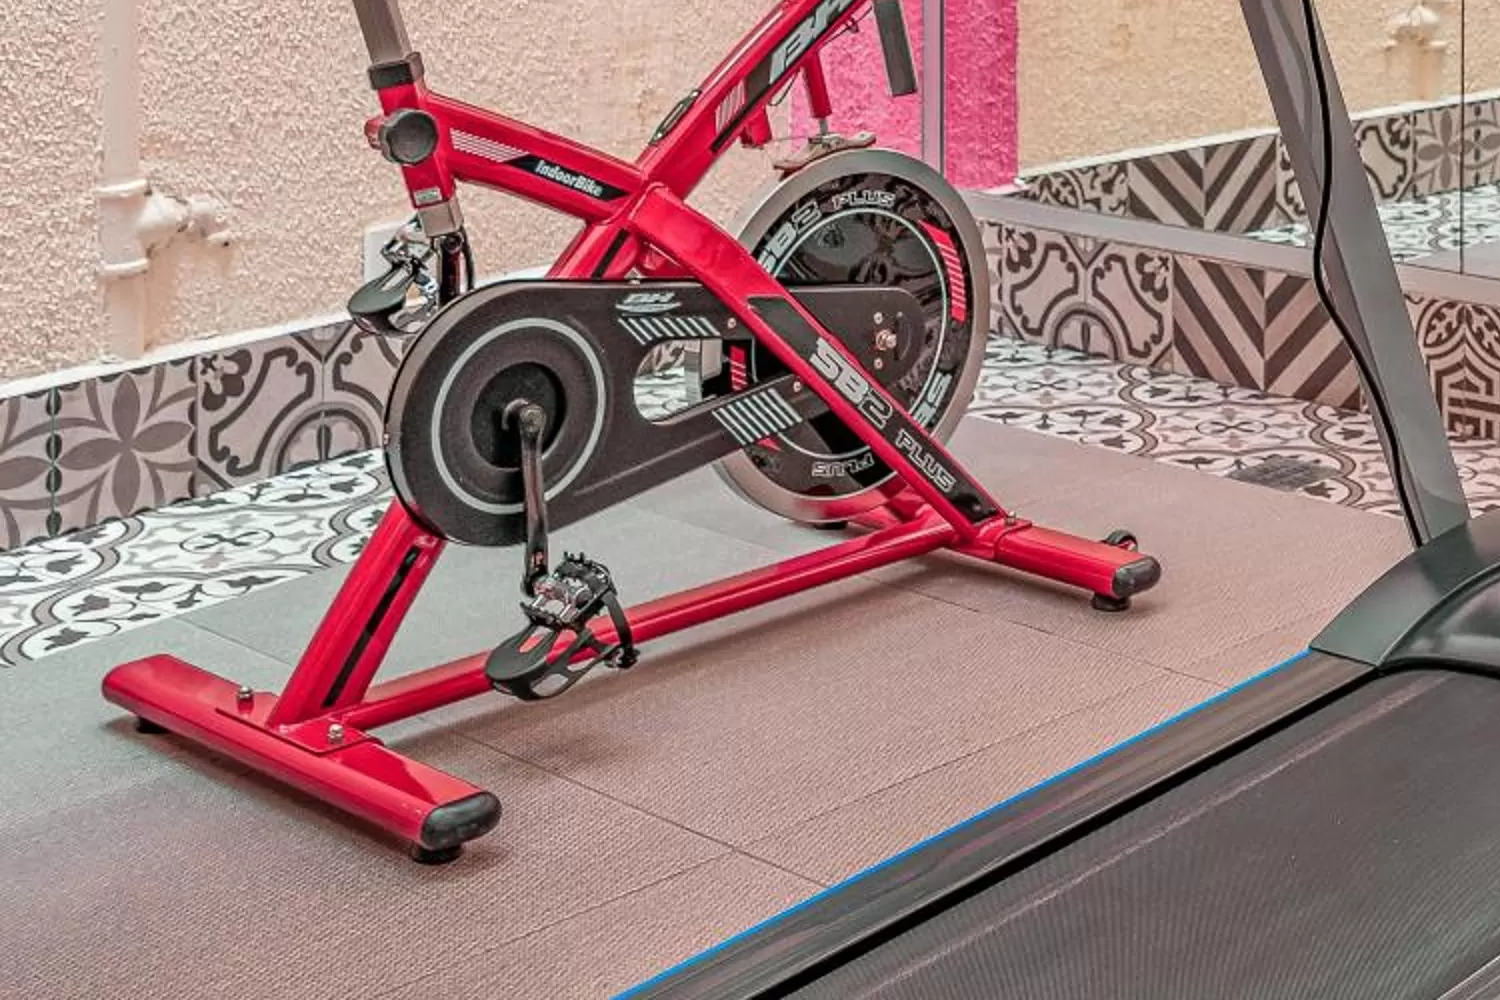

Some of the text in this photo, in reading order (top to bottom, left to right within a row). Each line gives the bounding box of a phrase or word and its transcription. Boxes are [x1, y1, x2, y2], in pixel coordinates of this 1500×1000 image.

[832, 189, 895, 209] PLUS
[810, 337, 956, 494] SB2 PLUS
